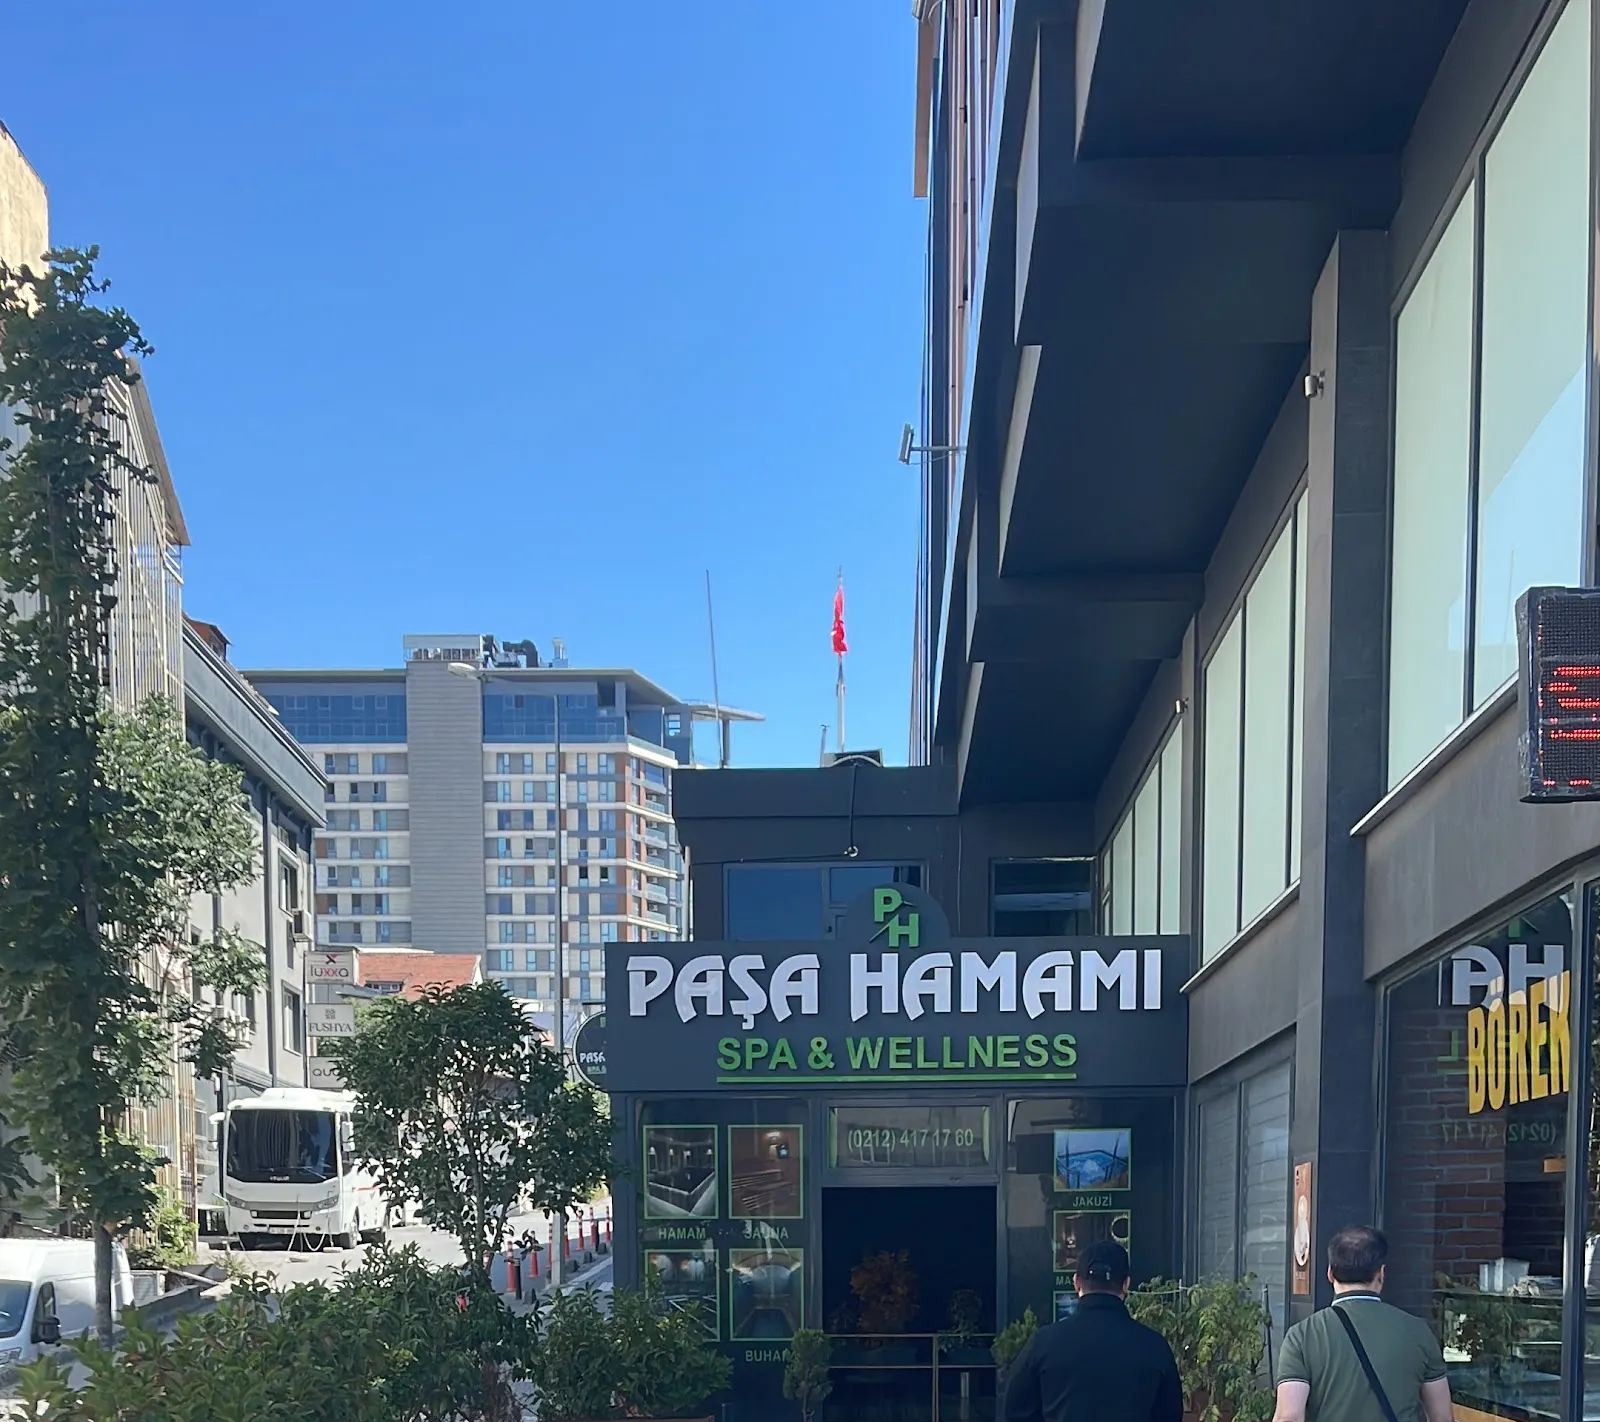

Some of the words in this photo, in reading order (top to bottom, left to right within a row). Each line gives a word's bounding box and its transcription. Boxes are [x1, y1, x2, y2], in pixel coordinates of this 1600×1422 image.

[627, 954, 819, 1030] PAŞA
[850, 949, 1162, 1021] HAMAMI
[309, 1023, 353, 1032] FUSHYA
[1468, 970, 1571, 1115] BÖREK
[717, 1037, 797, 1071] SPA
[807, 1037, 835, 1069] &
[846, 1034, 1077, 1070] WELLNESS
[848, 1129, 896, 1152] (0212)
[900, 1129, 929, 1147] 417
[933, 1129, 950, 1147] 17
[955, 1128, 974, 1146] 60
[658, 1227, 707, 1239] HAMAM
